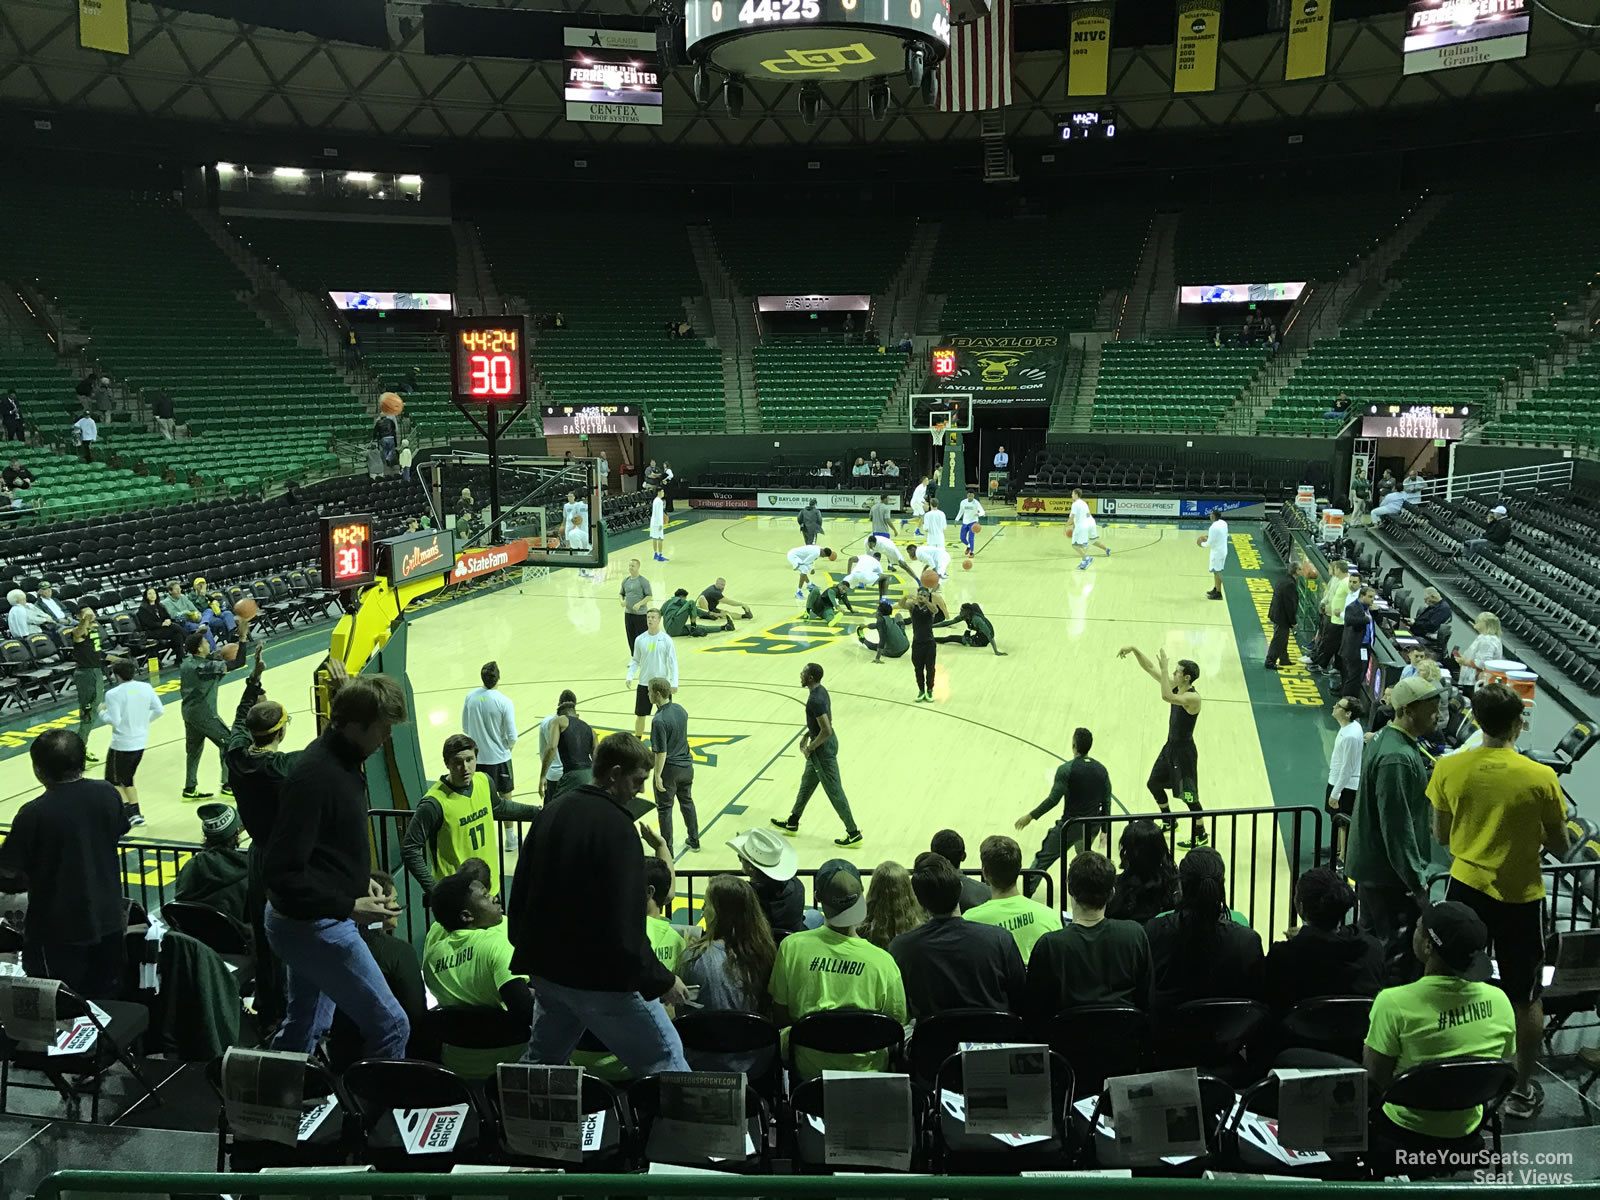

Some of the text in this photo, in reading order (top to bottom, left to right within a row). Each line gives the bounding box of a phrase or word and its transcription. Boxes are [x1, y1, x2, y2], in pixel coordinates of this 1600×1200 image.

[738, 0, 820, 24] 44:25
[1074, 31, 1106, 42] NIVC
[1439, 45, 1479, 58] Italian
[1443, 53, 1491, 67] Granite
[590, 104, 638, 116] CEN-TEX
[462, 330, 516, 352] 44:24
[951, 336, 1058, 348] BAYLOR
[471, 355, 513, 395] 30
[936, 358, 953, 373] 30
[563, 425, 617, 434] BASKETBALL
[574, 416, 607, 425] BAYLOR
[1400, 417, 1438, 428] BAYLOR
[1386, 427, 1451, 438] BASKETBALL
[713, 492, 733, 500] Waco
[339, 548, 359, 575] 30
[466, 551, 509, 575] StateFarm
[459, 806, 489, 827] BAYLOR
[468, 823, 487, 851] 17
[434, 946, 474, 974] #ALLINBU
[809, 956, 866, 977] #ALLINBU
[1437, 1000, 1493, 1033] #ALLINBU
[299, 1103, 327, 1135] BRICK
[428, 1116, 447, 1148] ACME
[437, 1115, 458, 1148] BRICK
[584, 1114, 598, 1146] BRICK
